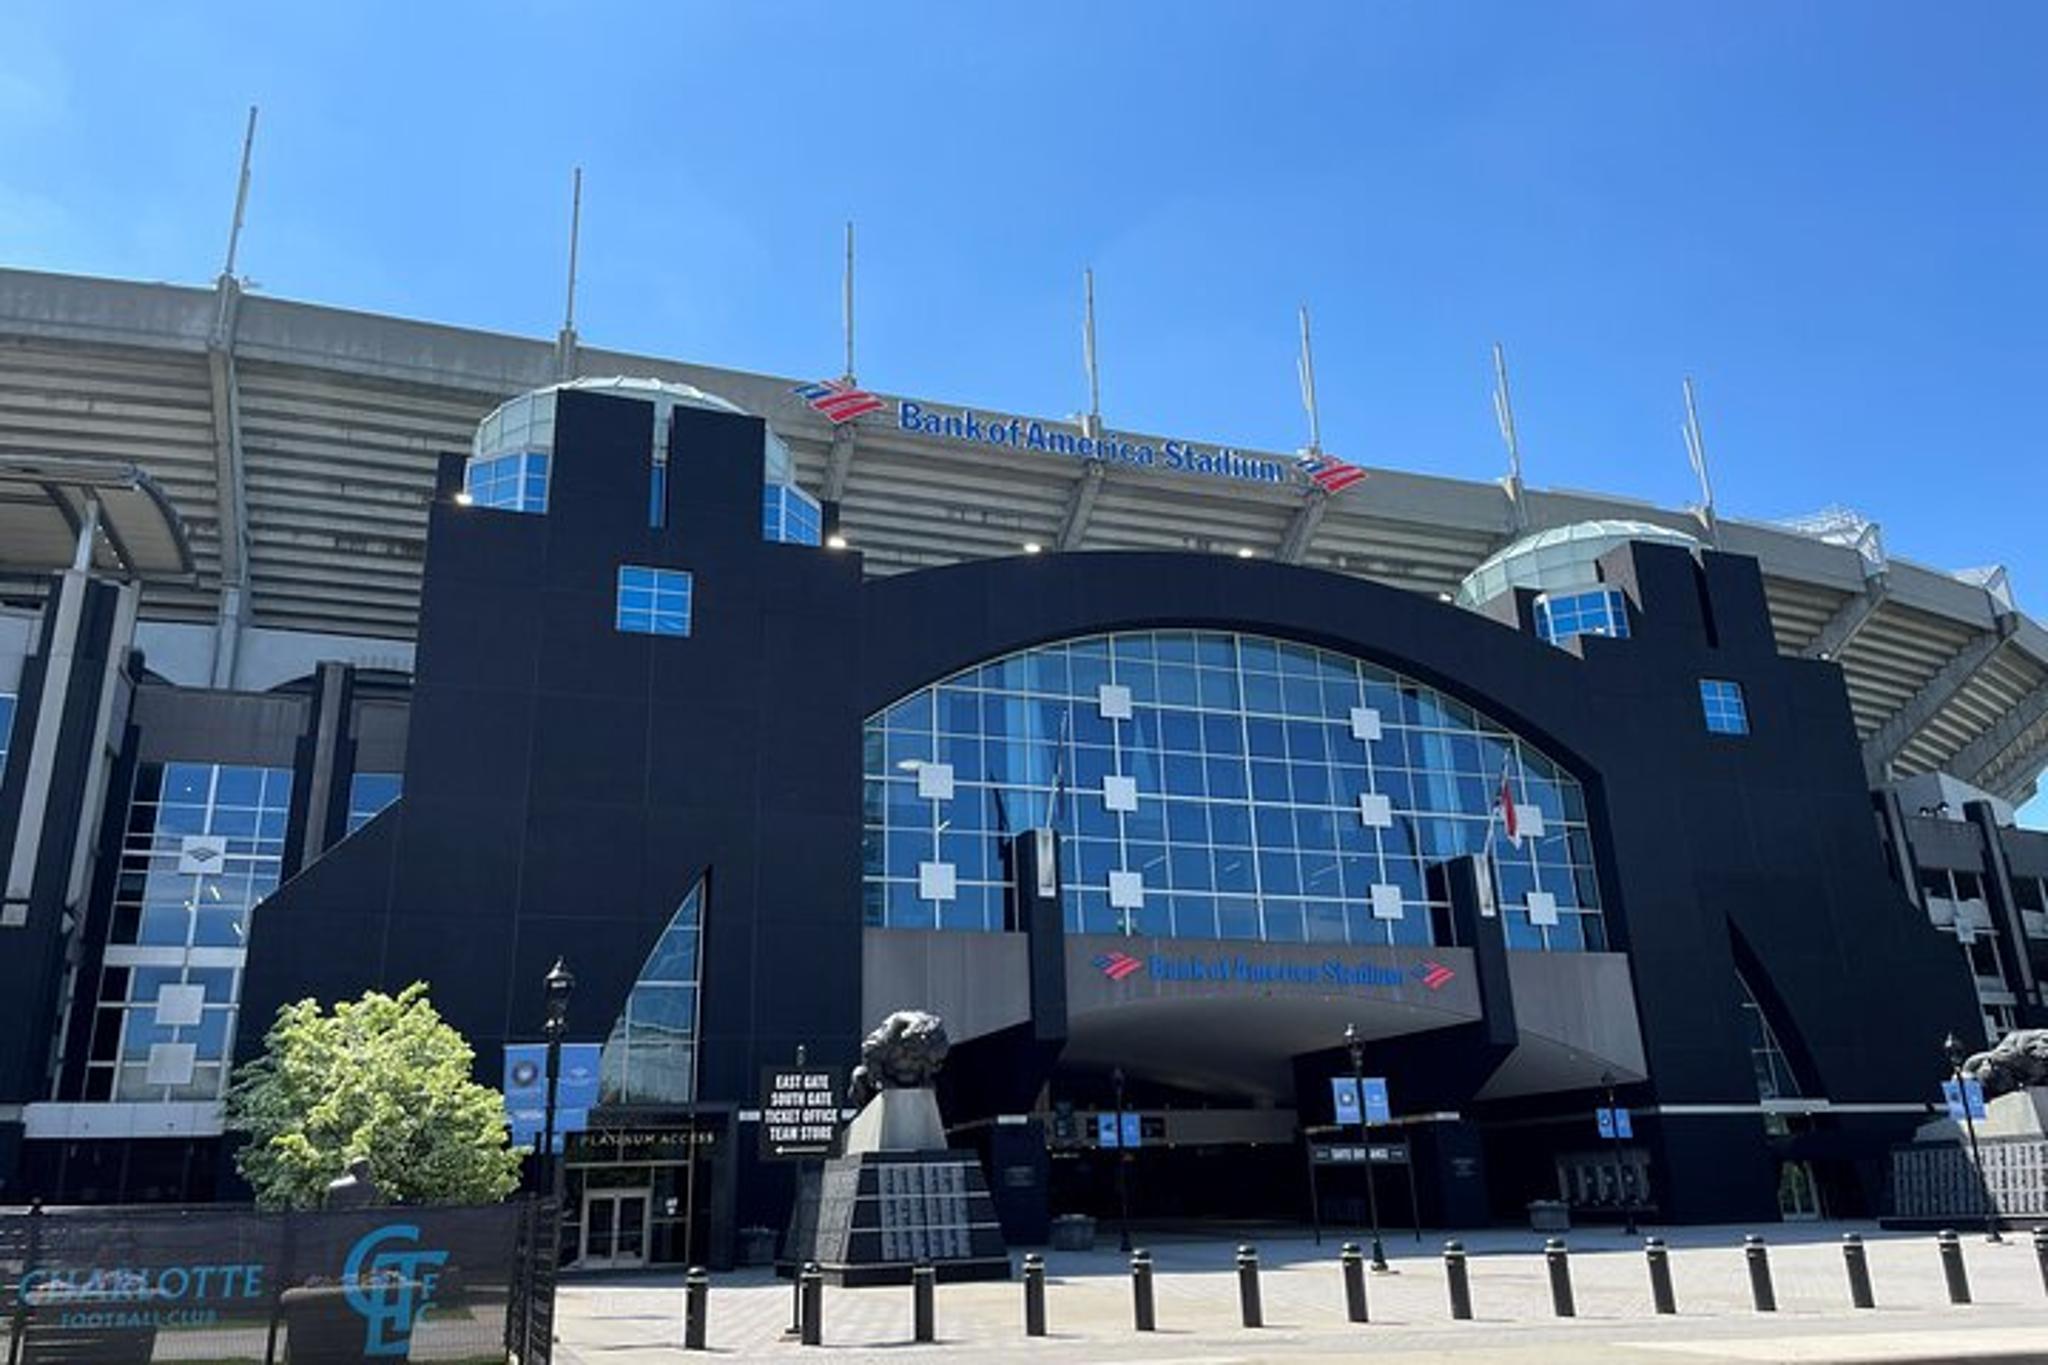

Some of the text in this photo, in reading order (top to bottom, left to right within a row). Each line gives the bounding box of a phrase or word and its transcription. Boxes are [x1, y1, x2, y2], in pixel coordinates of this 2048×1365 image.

[900, 402, 1284, 482] Bank of America Stadium
[1150, 954, 1206, 981] Bank
[776, 1074, 829, 1090] EAST GATE
[770, 1091, 832, 1107] SOUTH GATE
[765, 1108, 838, 1124] TICKET OFFICE
[769, 1125, 833, 1141] TEAM STORE
[18, 1265, 264, 1305] CHARLOTTE
[61, 1308, 219, 1329] FOOTBALL CLUB
